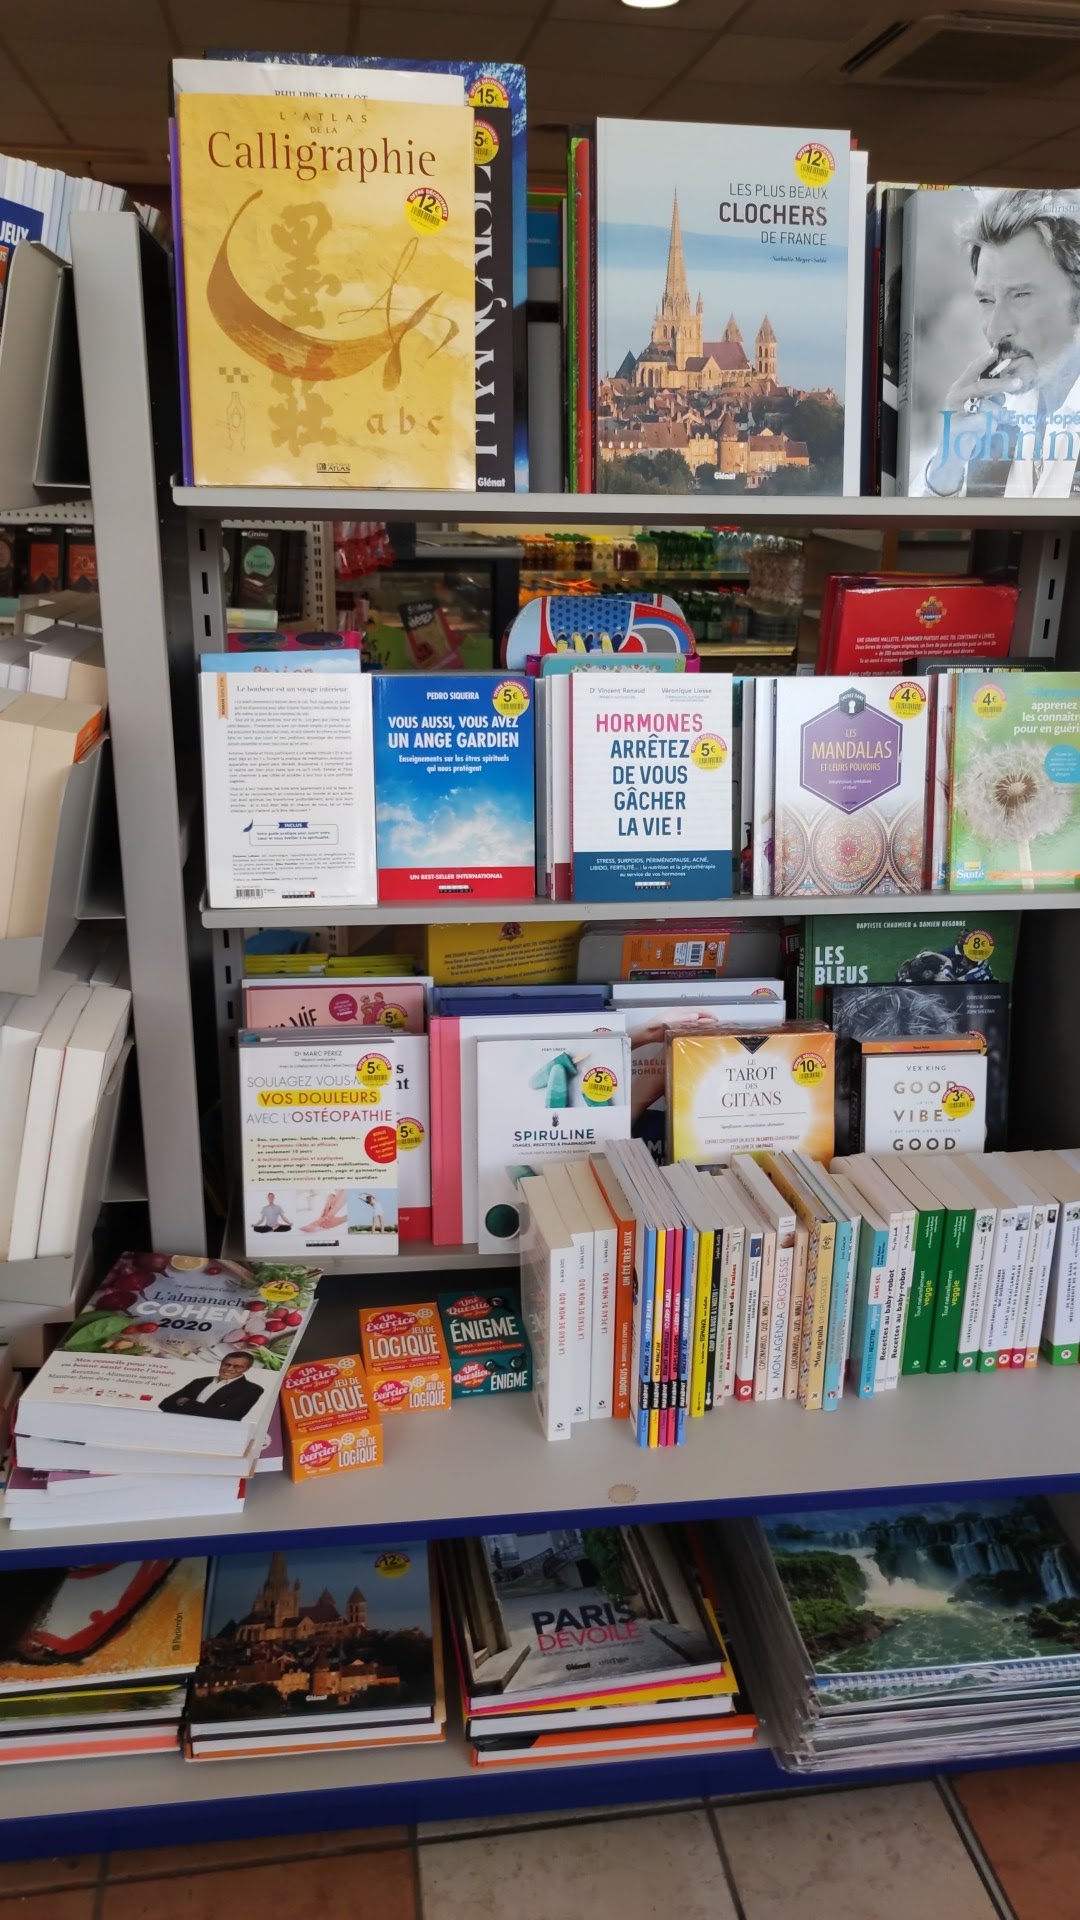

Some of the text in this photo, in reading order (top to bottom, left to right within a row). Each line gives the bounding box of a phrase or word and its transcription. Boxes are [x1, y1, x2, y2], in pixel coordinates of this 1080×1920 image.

[280, 112, 368, 123] L'ATLAS
[208, 131, 436, 183] Calligraphie
[805, 148, 826, 166] 12€
[730, 183, 827, 199] LES PLUS BEAUX
[419, 194, 440, 213] 12€
[719, 202, 827, 226] CLOCHERS
[761, 231, 827, 246] DE FRANCE
[939, 410, 1080, 470] Johnn
[477, 477, 505, 488] Glénat
[249, 685, 274, 693] bonheur
[319, 685, 347, 693] intérieur
[427, 692, 479, 700] PEDRO SIQUEIRA
[503, 689, 518, 702] 5€
[661, 687, 692, 695] Véronique
[901, 688, 916, 702] 4€
[983, 693, 997, 706] 4€
[1031, 702, 1077, 712] apprenez
[388, 715, 519, 731] VOUS AUSSI, VOUS AVEZ
[596, 714, 703, 732] HORMONES
[845, 729, 856, 737] LES
[1013, 726, 1038, 736] pour
[388, 731, 519, 749] UN ANGE GARDIEN
[610, 733, 690, 758] ARRÊTEZ
[701, 743, 716, 756] 5€
[811, 741, 892, 759] MANDALAS
[399, 755, 443, 764] Enseignements
[455, 754, 464, 763] les
[465, 754, 481, 762] êtres
[482, 754, 509, 764] spirituels
[427, 765, 437, 774] qui
[453, 765, 482, 774] protègent
[820, 763, 881, 772] ET LEURS POUVOIRS
[613, 766, 688, 785] DE VOUS
[614, 787, 686, 810] GÂCHER
[618, 818, 639, 836] LA
[643, 817, 672, 835] VIE
[956, 869, 985, 879] Santé
[972, 937, 985, 949] 8€
[815, 946, 845, 965] LES
[814, 965, 869, 985] BLEUS
[385, 1012, 399, 1023] 5€
[366, 1061, 382, 1074] 5€
[800, 1060, 818, 1072] 10€
[594, 1072, 608, 1083] 5€
[726, 1066, 777, 1082] TAROT
[248, 1076, 312, 1088] SOULAGEZ
[260, 1092, 377, 1105] VOS DOULEURS
[722, 1091, 782, 1108] GITANS
[952, 1090, 964, 1102] 3€
[246, 1108, 392, 1124] AVEC L'OSTÉOPATHIE
[400, 1126, 414, 1138] 5€
[514, 1129, 595, 1142] SPIRULINE
[892, 1137, 956, 1151] GOOD
[621, 1231, 632, 1286] UN ÉTÉ TRÈS JEUX
[274, 1282, 291, 1291] 4€
[914, 1270, 925, 1318] Tout naturellement
[924, 1280, 933, 1306] veggie
[153, 1290, 245, 1309] L'almanach
[136, 1300, 250, 1324] COHEN
[771, 1256, 790, 1379] MON AGENDA GROSSESSE
[879, 1269, 895, 1360] Recettes au baby-robot
[158, 1318, 212, 1333] 2020
[366, 1314, 418, 1332] Exercice
[559, 1321, 566, 1329] DE
[814, 1275, 828, 1368] Mon agenda DE GROSSESSE
[449, 1317, 519, 1342] ÉNIGME
[868, 1329, 876, 1352] RECETTES
[74, 1363, 98, 1371] bonne
[100, 1364, 122, 1372] santé
[124, 1365, 145, 1373] toute
[147, 1367, 176, 1376] l'année
[123, 1360, 146, 1368] pour
[725, 1361, 731, 1371] Au
[285, 1368, 338, 1389] Exercice
[490, 1370, 527, 1390] ÉNIGME
[531, 1600, 636, 1635] PARIS
[537, 1619, 644, 1652] DÉVOILÉ
[565, 1662, 591, 1671] Glénat
